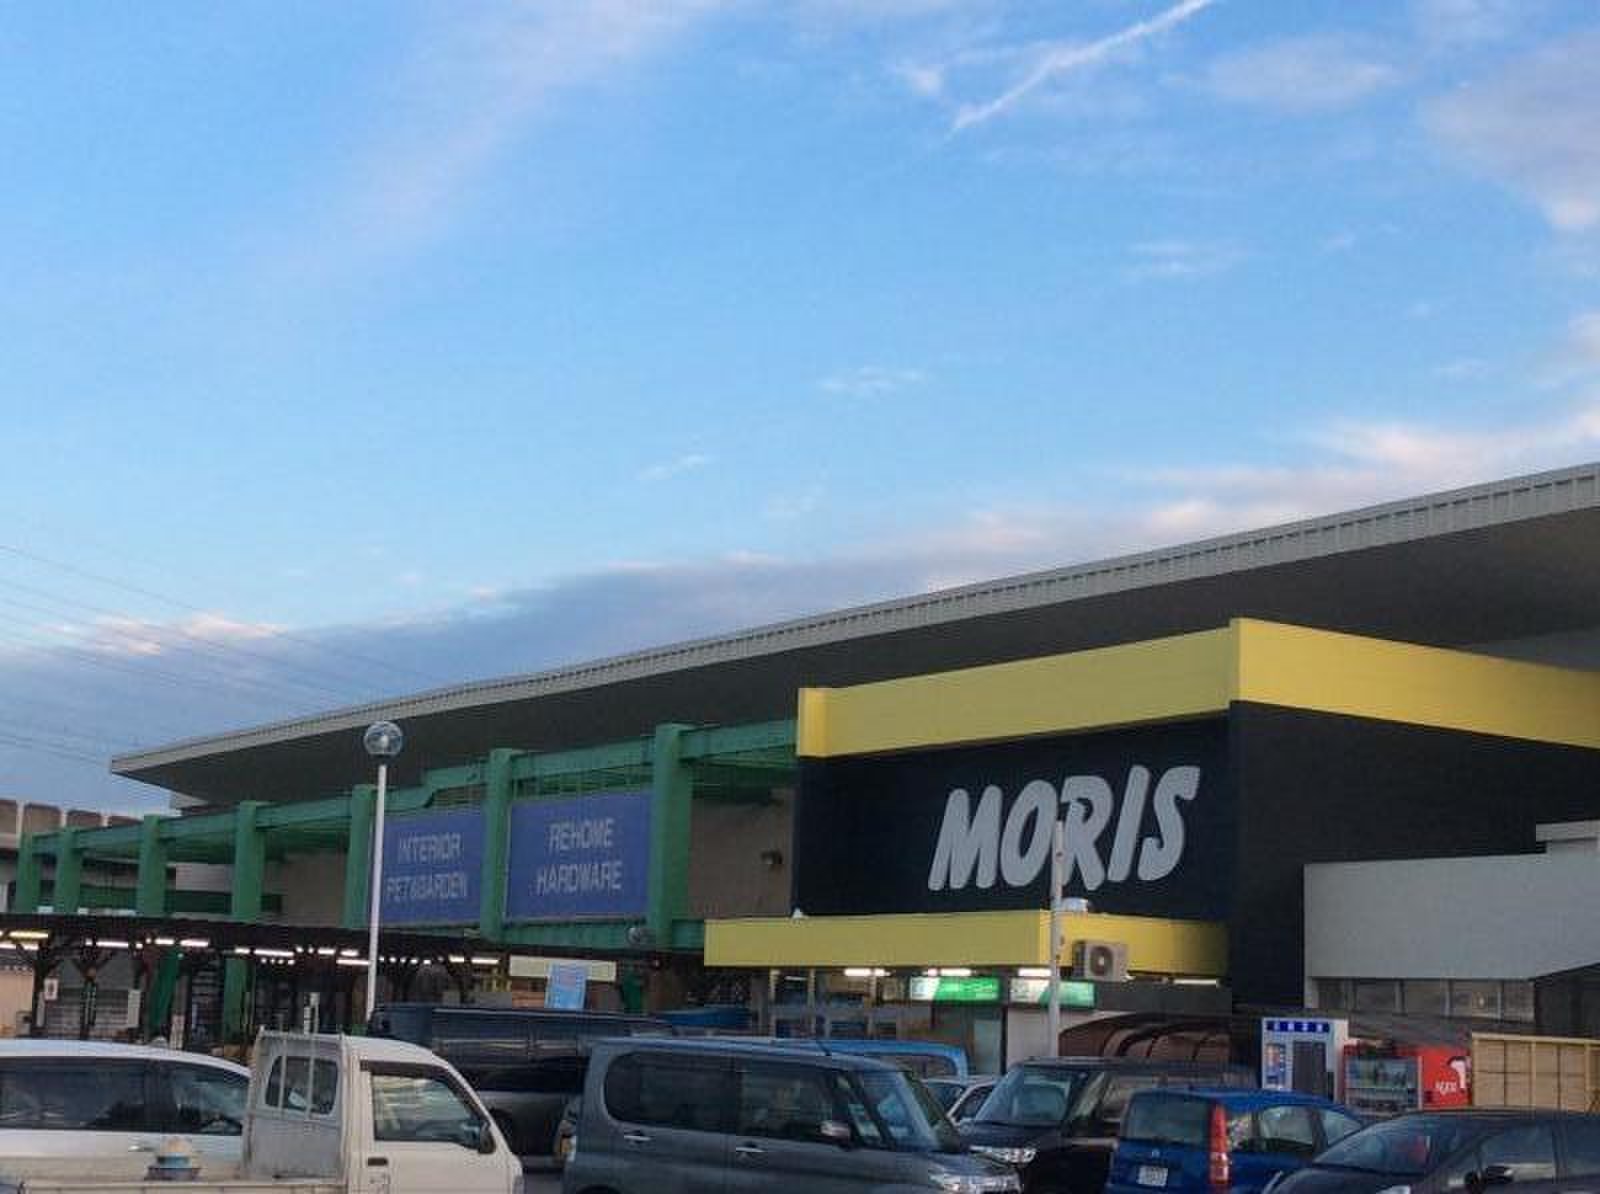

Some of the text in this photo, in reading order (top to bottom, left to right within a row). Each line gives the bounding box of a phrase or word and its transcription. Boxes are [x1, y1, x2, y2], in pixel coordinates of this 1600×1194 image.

[927, 764, 1200, 891] MORIS
[398, 833, 462, 863] INTERIOR
[537, 862, 621, 894] HARDWARE
